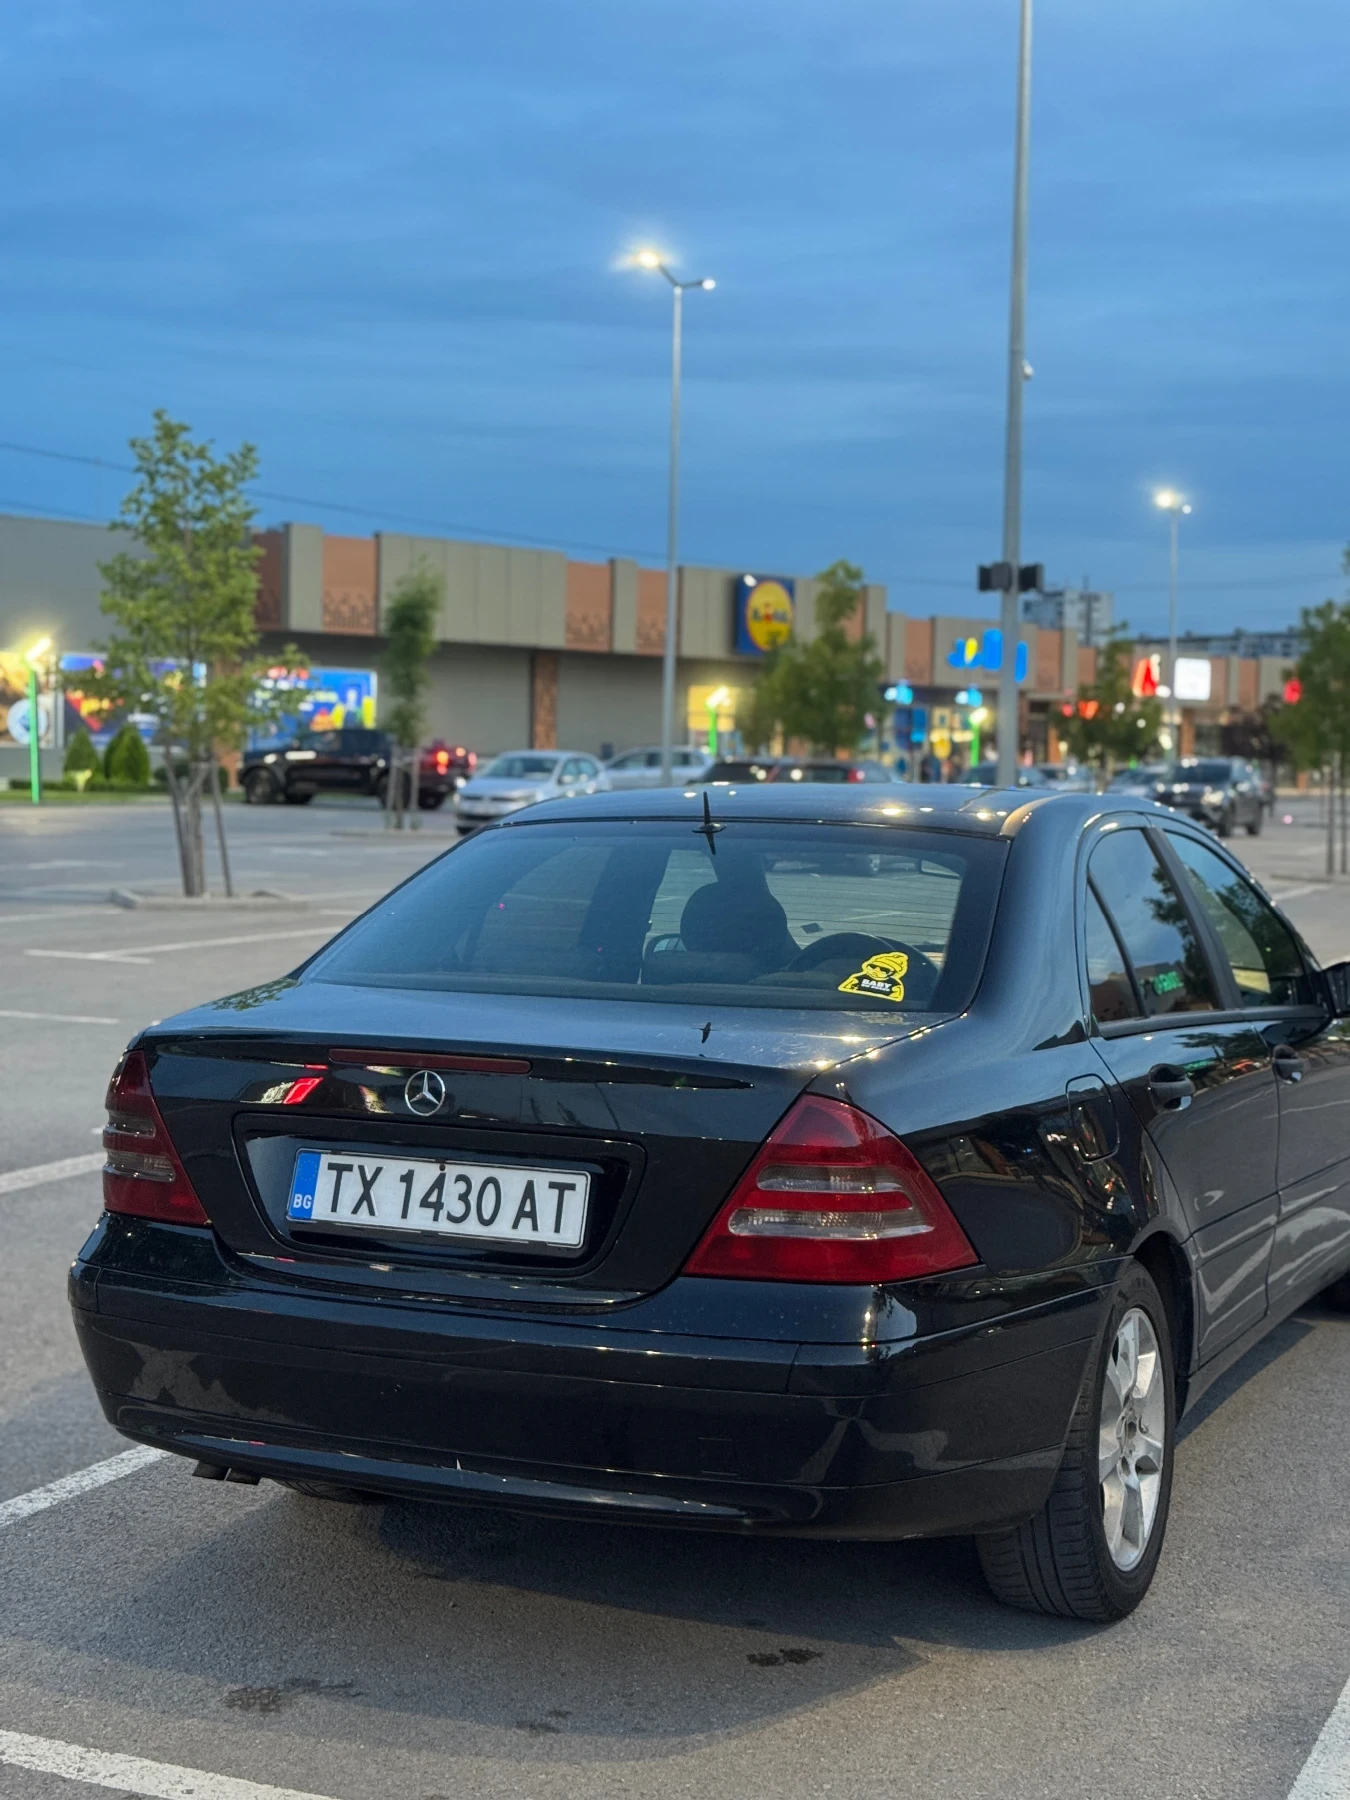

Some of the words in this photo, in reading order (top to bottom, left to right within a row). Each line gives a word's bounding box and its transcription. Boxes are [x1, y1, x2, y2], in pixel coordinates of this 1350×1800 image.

[292, 1193, 312, 1209] BG
[327, 1162, 384, 1217] TX
[399, 1169, 502, 1227] 1430
[511, 1179, 577, 1234] AT
